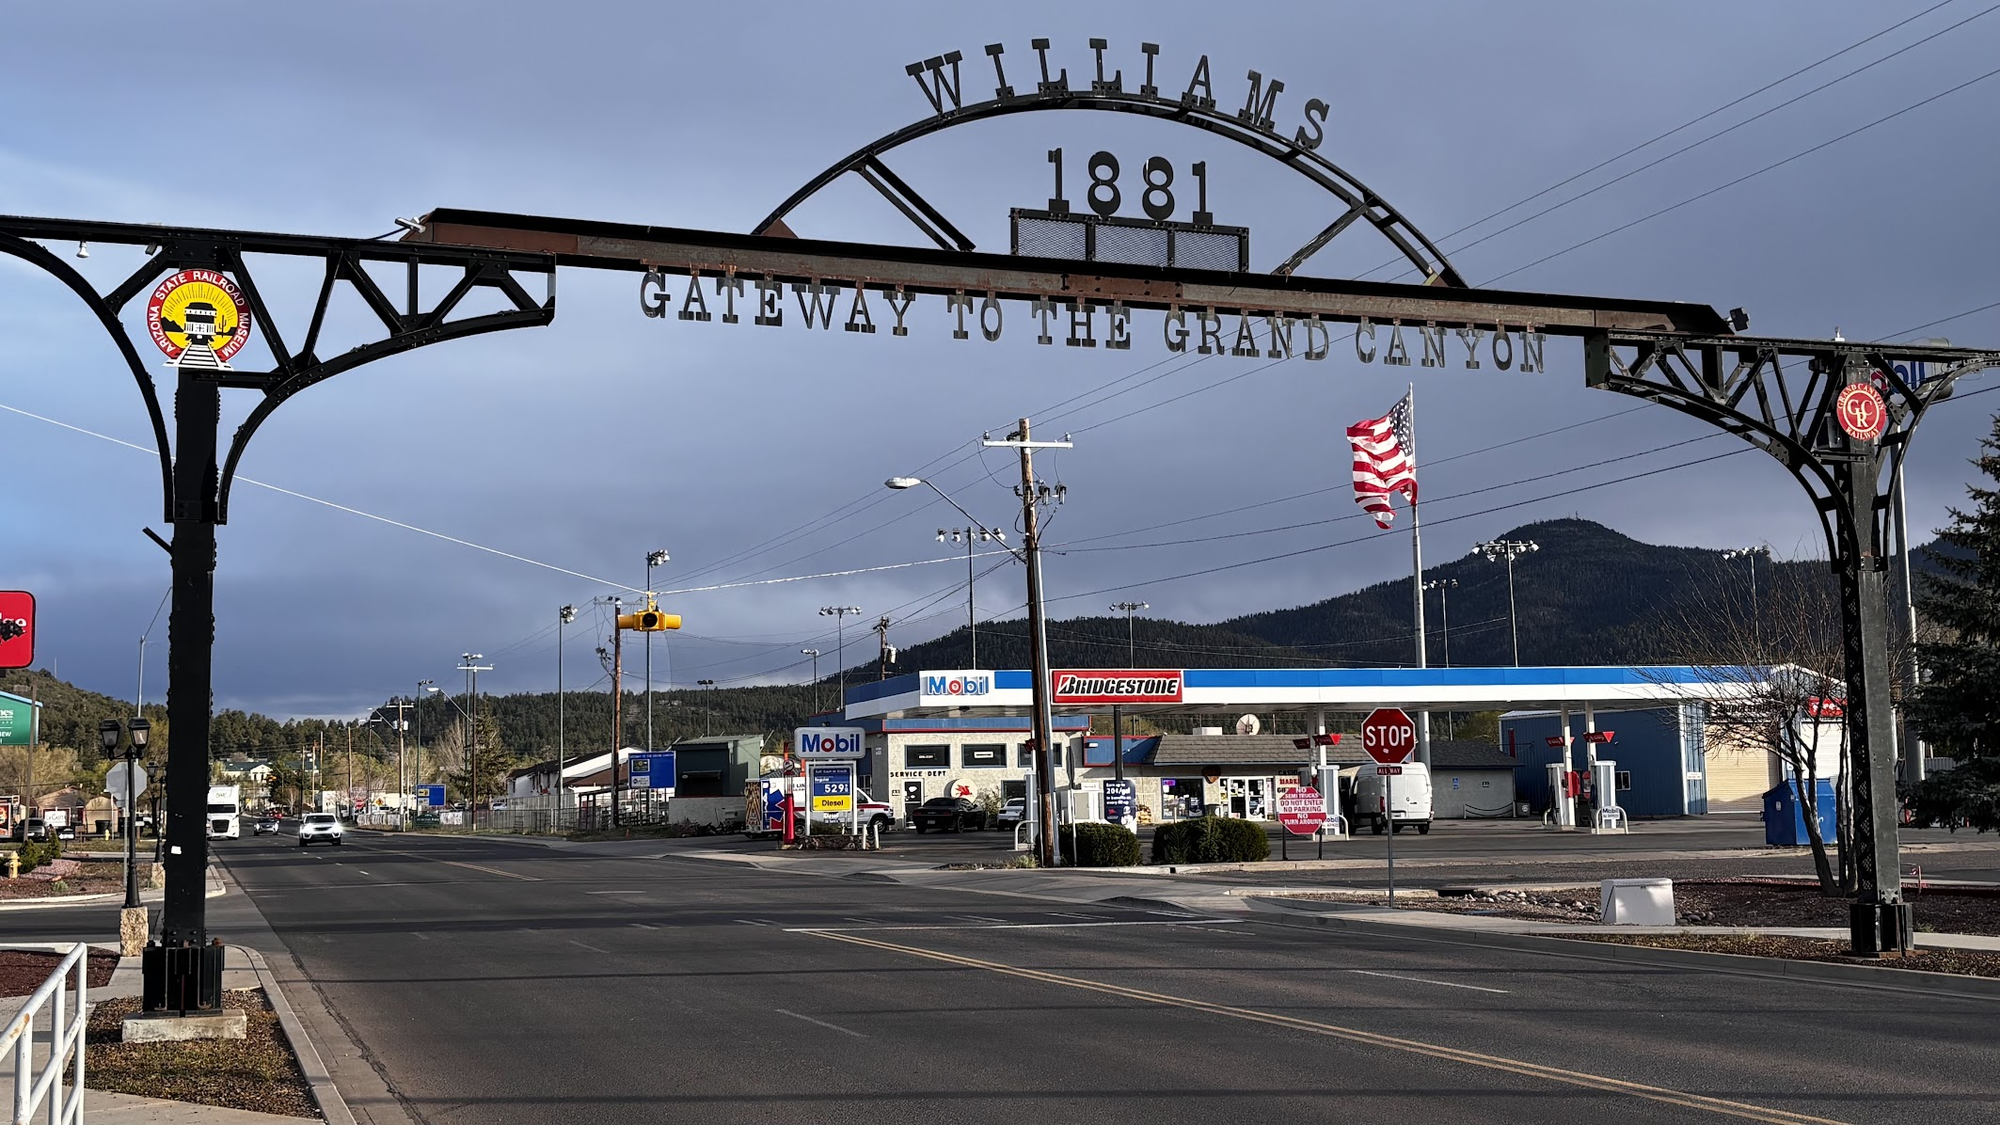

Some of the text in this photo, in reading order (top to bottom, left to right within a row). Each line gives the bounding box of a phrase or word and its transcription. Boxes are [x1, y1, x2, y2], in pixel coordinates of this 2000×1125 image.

[905, 38, 1330, 150] WILLIAMS
[1048, 148, 1215, 225] 1881
[149, 271, 249, 357] ARIZONA STATE RAILROAD MUSEUM
[640, 270, 1545, 374] GATEWAY TO THE GRAND CANYON
[1837, 383, 1887, 410] GRAND CANYON
[1846, 426, 1880, 440] RAILWAY
[928, 676, 989, 694] Mobil
[1058, 677, 1178, 695] BRIDGESTONE
[802, 733, 860, 752] Mobil
[1366, 726, 1411, 746] STOP
[824, 783, 845, 793] 529
[821, 799, 844, 807] Diesel
